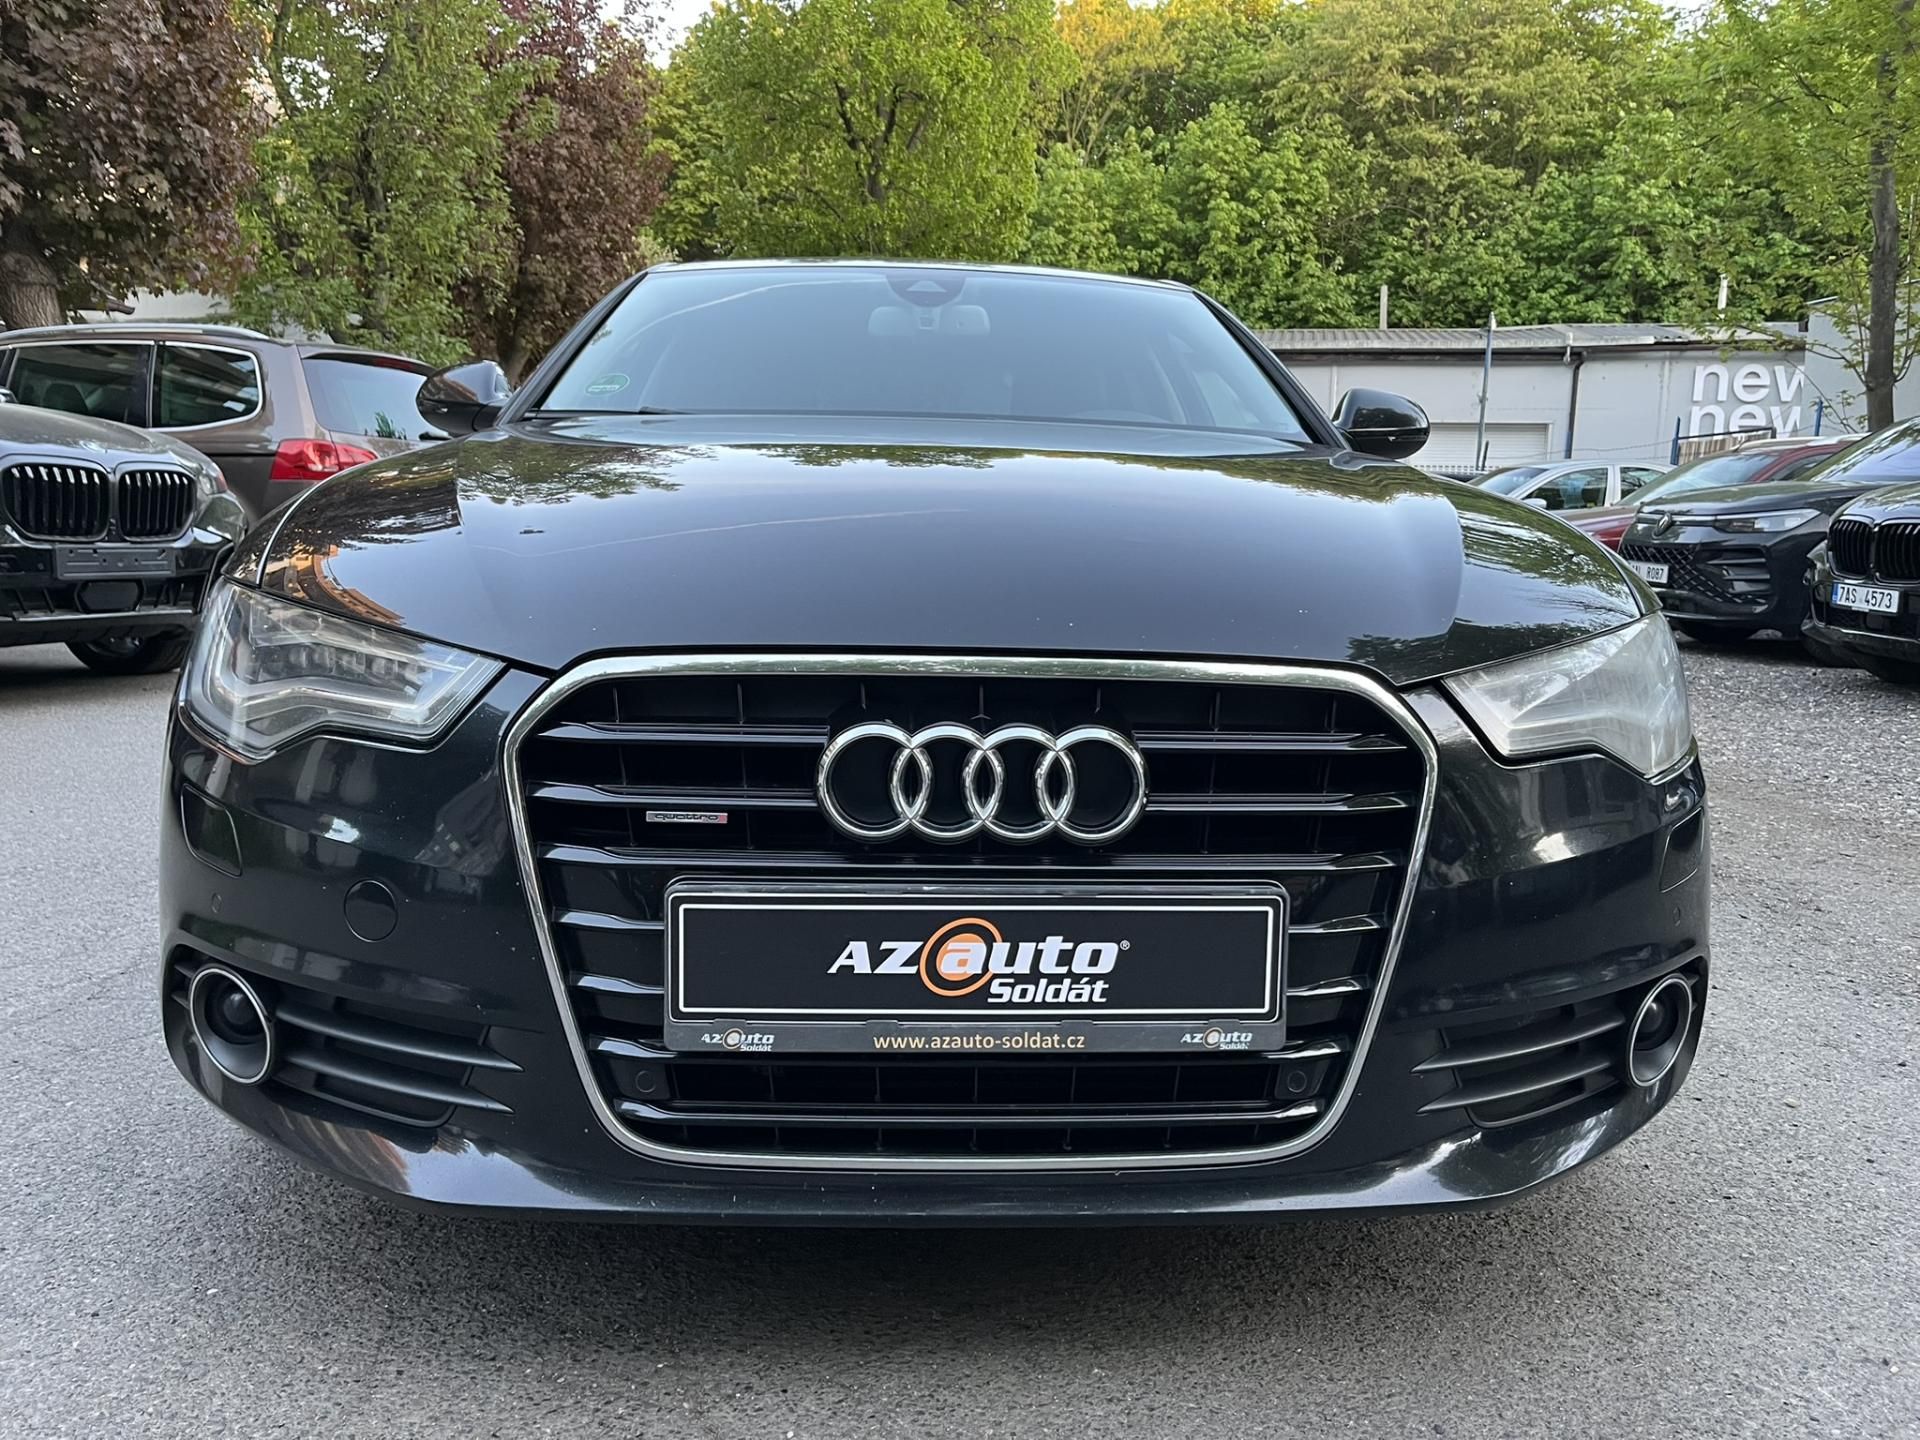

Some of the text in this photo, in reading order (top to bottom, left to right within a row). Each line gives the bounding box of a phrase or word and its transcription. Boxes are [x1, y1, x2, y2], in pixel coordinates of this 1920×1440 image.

[1839, 586, 1858, 604] 7AS
[1864, 589, 1893, 609] 4573
[655, 811, 719, 822] quattro
[987, 976, 1110, 1003] Soldát
[873, 1031, 1086, 1049] www.azauto-soldat.cz
